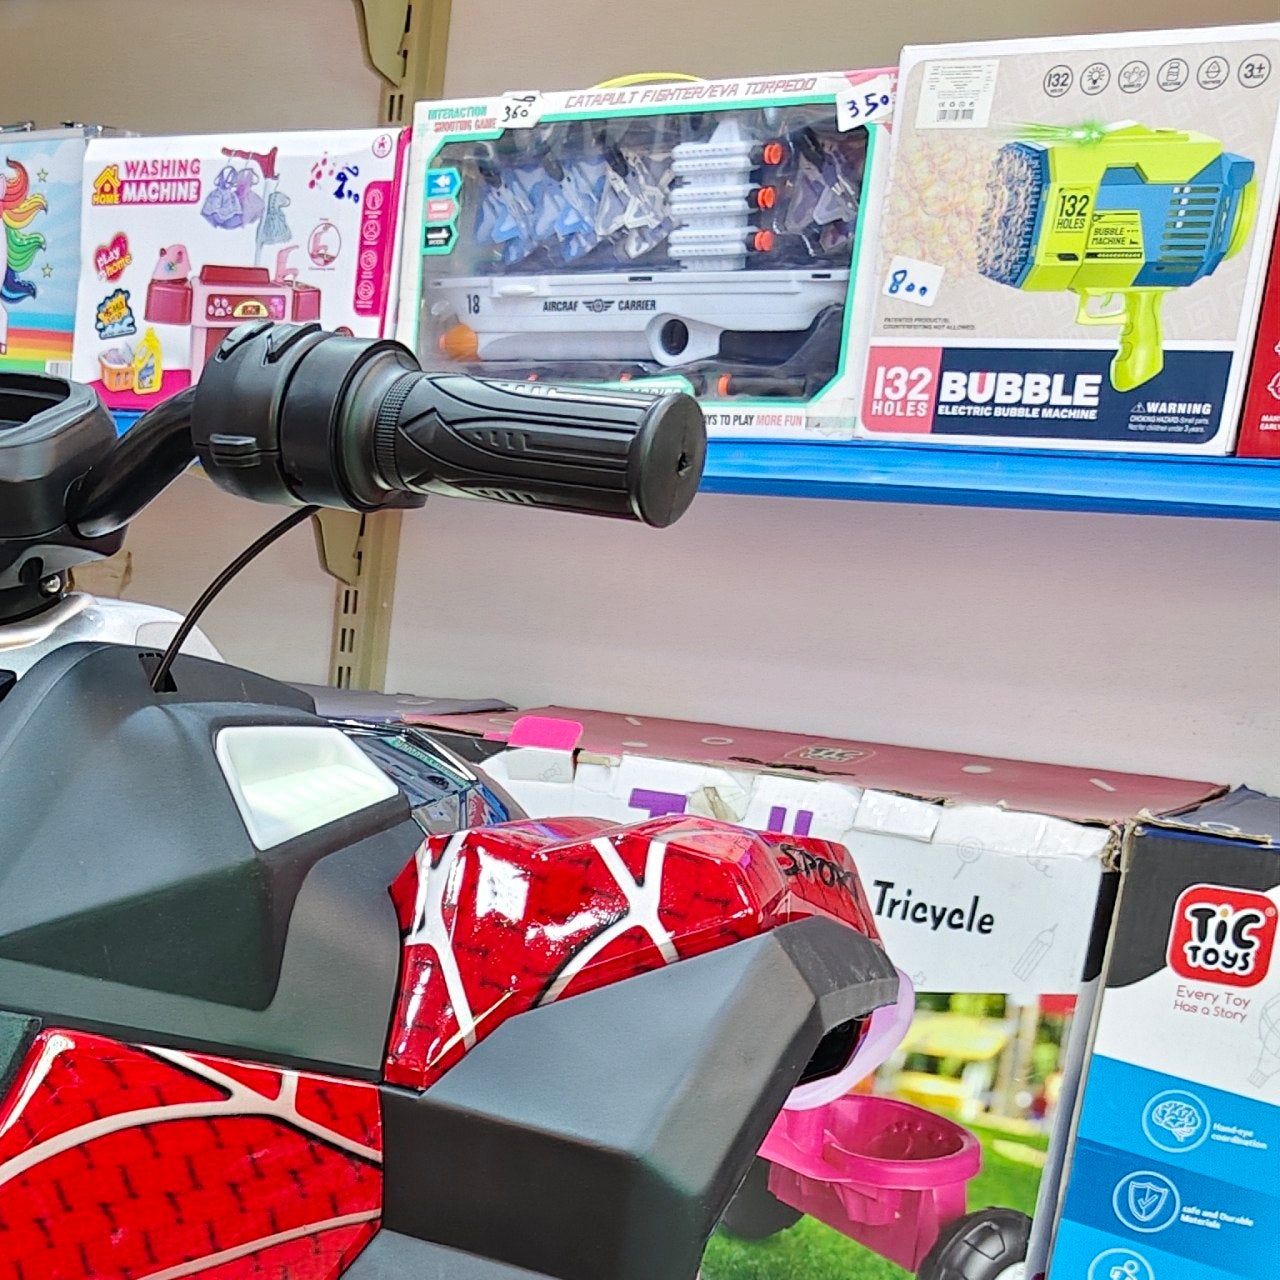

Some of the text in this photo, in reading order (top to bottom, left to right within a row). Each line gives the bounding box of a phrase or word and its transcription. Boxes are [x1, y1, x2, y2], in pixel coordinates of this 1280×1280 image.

[1244, 63, 1265, 79] 3+
[1047, 73, 1070, 87] 132
[564, 90, 639, 109] CATAPULT
[746, 77, 817, 95] TORPEDO
[428, 105, 488, 120] INTERACTION
[847, 93, 890, 119] 350
[475, 118, 497, 129] GAME
[124, 159, 200, 178] WASHING
[92, 194, 120, 205] HOME
[122, 180, 199, 203] MACHINE
[1059, 195, 1089, 217] 132
[1056, 218, 1086, 230] HOLES
[1094, 227, 1124, 236] BUBBLE
[1092, 237, 1125, 245] MACHINE
[466, 294, 480, 315] 18
[618, 300, 656, 312] CARRIER
[873, 366, 933, 401] 132
[939, 371, 1102, 406] BUBBLE
[871, 400, 928, 417] HOLES
[937, 404, 1098, 420] ELECTRIC BUBBLE MACHINE
[1146, 402, 1212, 415] WARNING
[720, 415, 730, 426] TO
[733, 414, 754, 426] PLAY
[756, 415, 782, 426] MORE
[784, 415, 802, 426] FUN
[873, 880, 995, 935] Tricycle
[1176, 985, 1251, 1010] Every Toy
[1173, 999, 1247, 1023] Has a Story
[1201, 1210, 1219, 1219] and
